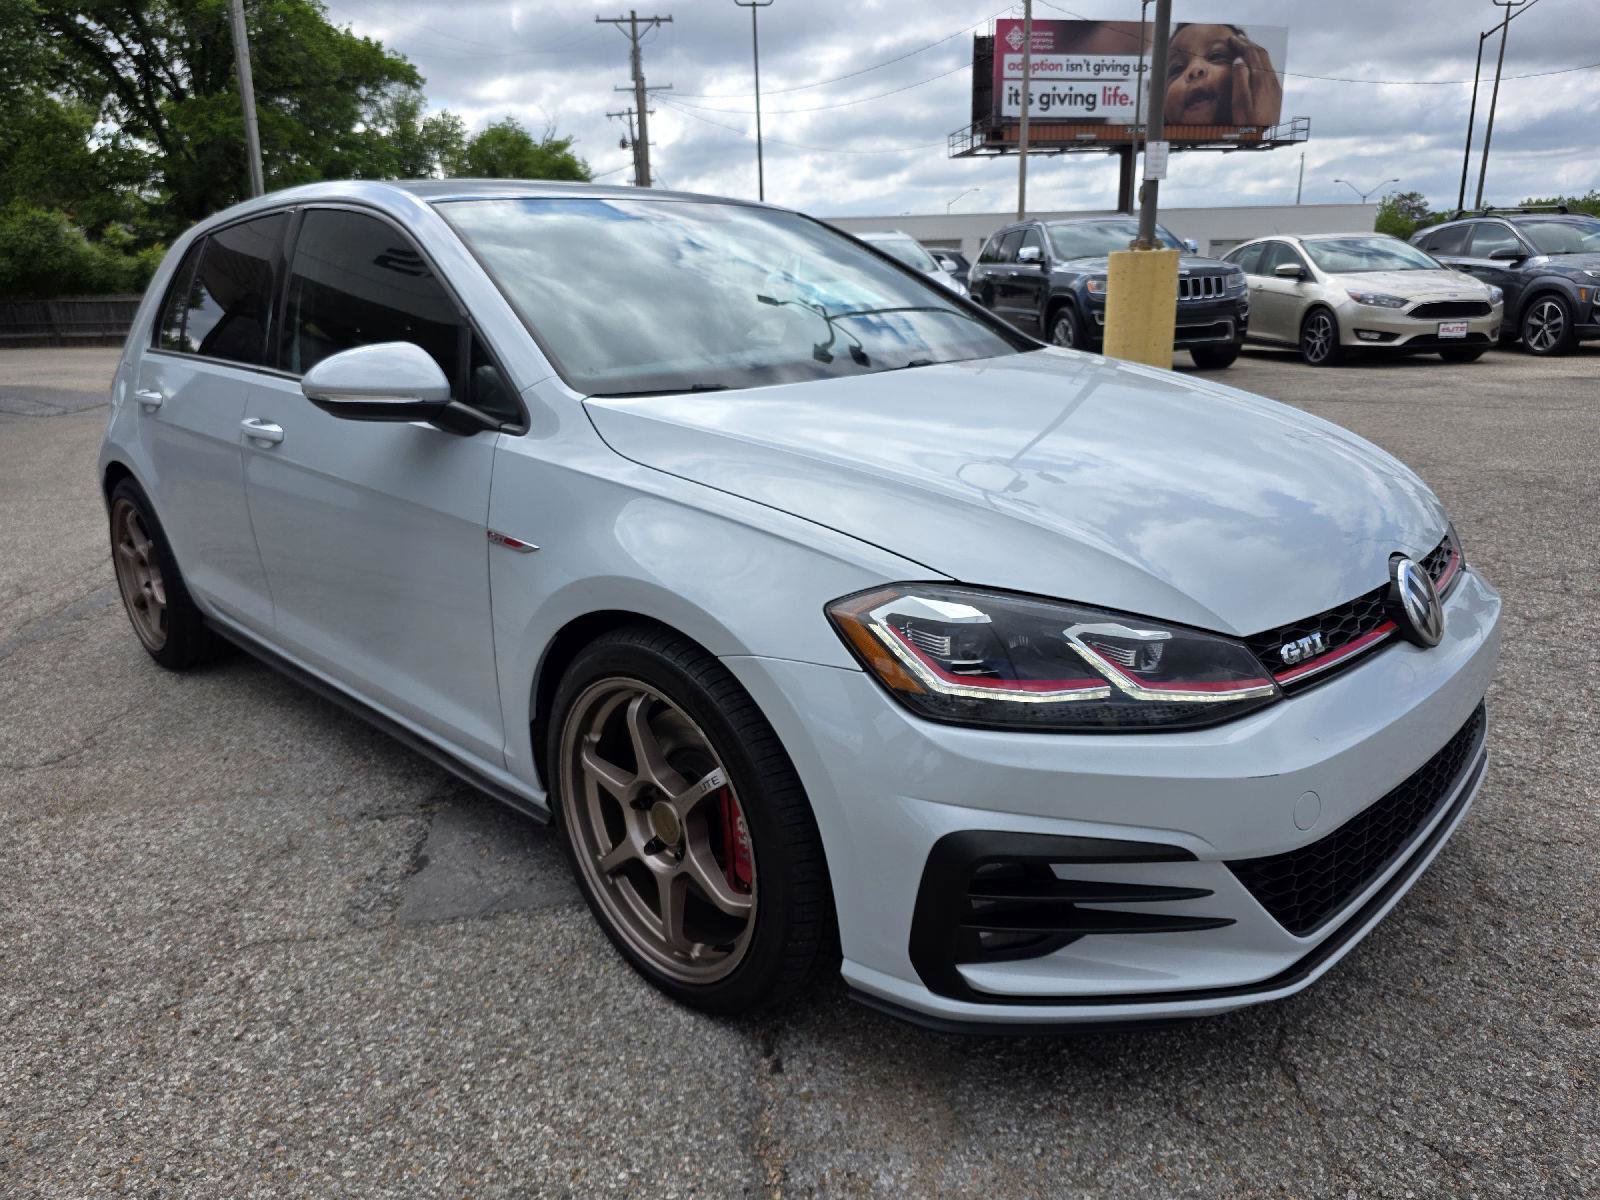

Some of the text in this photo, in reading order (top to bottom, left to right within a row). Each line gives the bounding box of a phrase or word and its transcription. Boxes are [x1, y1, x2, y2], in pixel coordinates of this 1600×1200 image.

[1008, 59, 1063, 75] adption
[1066, 59, 1090, 72] isn't
[1093, 59, 1130, 76] giving
[1008, 86, 1135, 112] its giving life.
[1281, 632, 1325, 664] GTI
